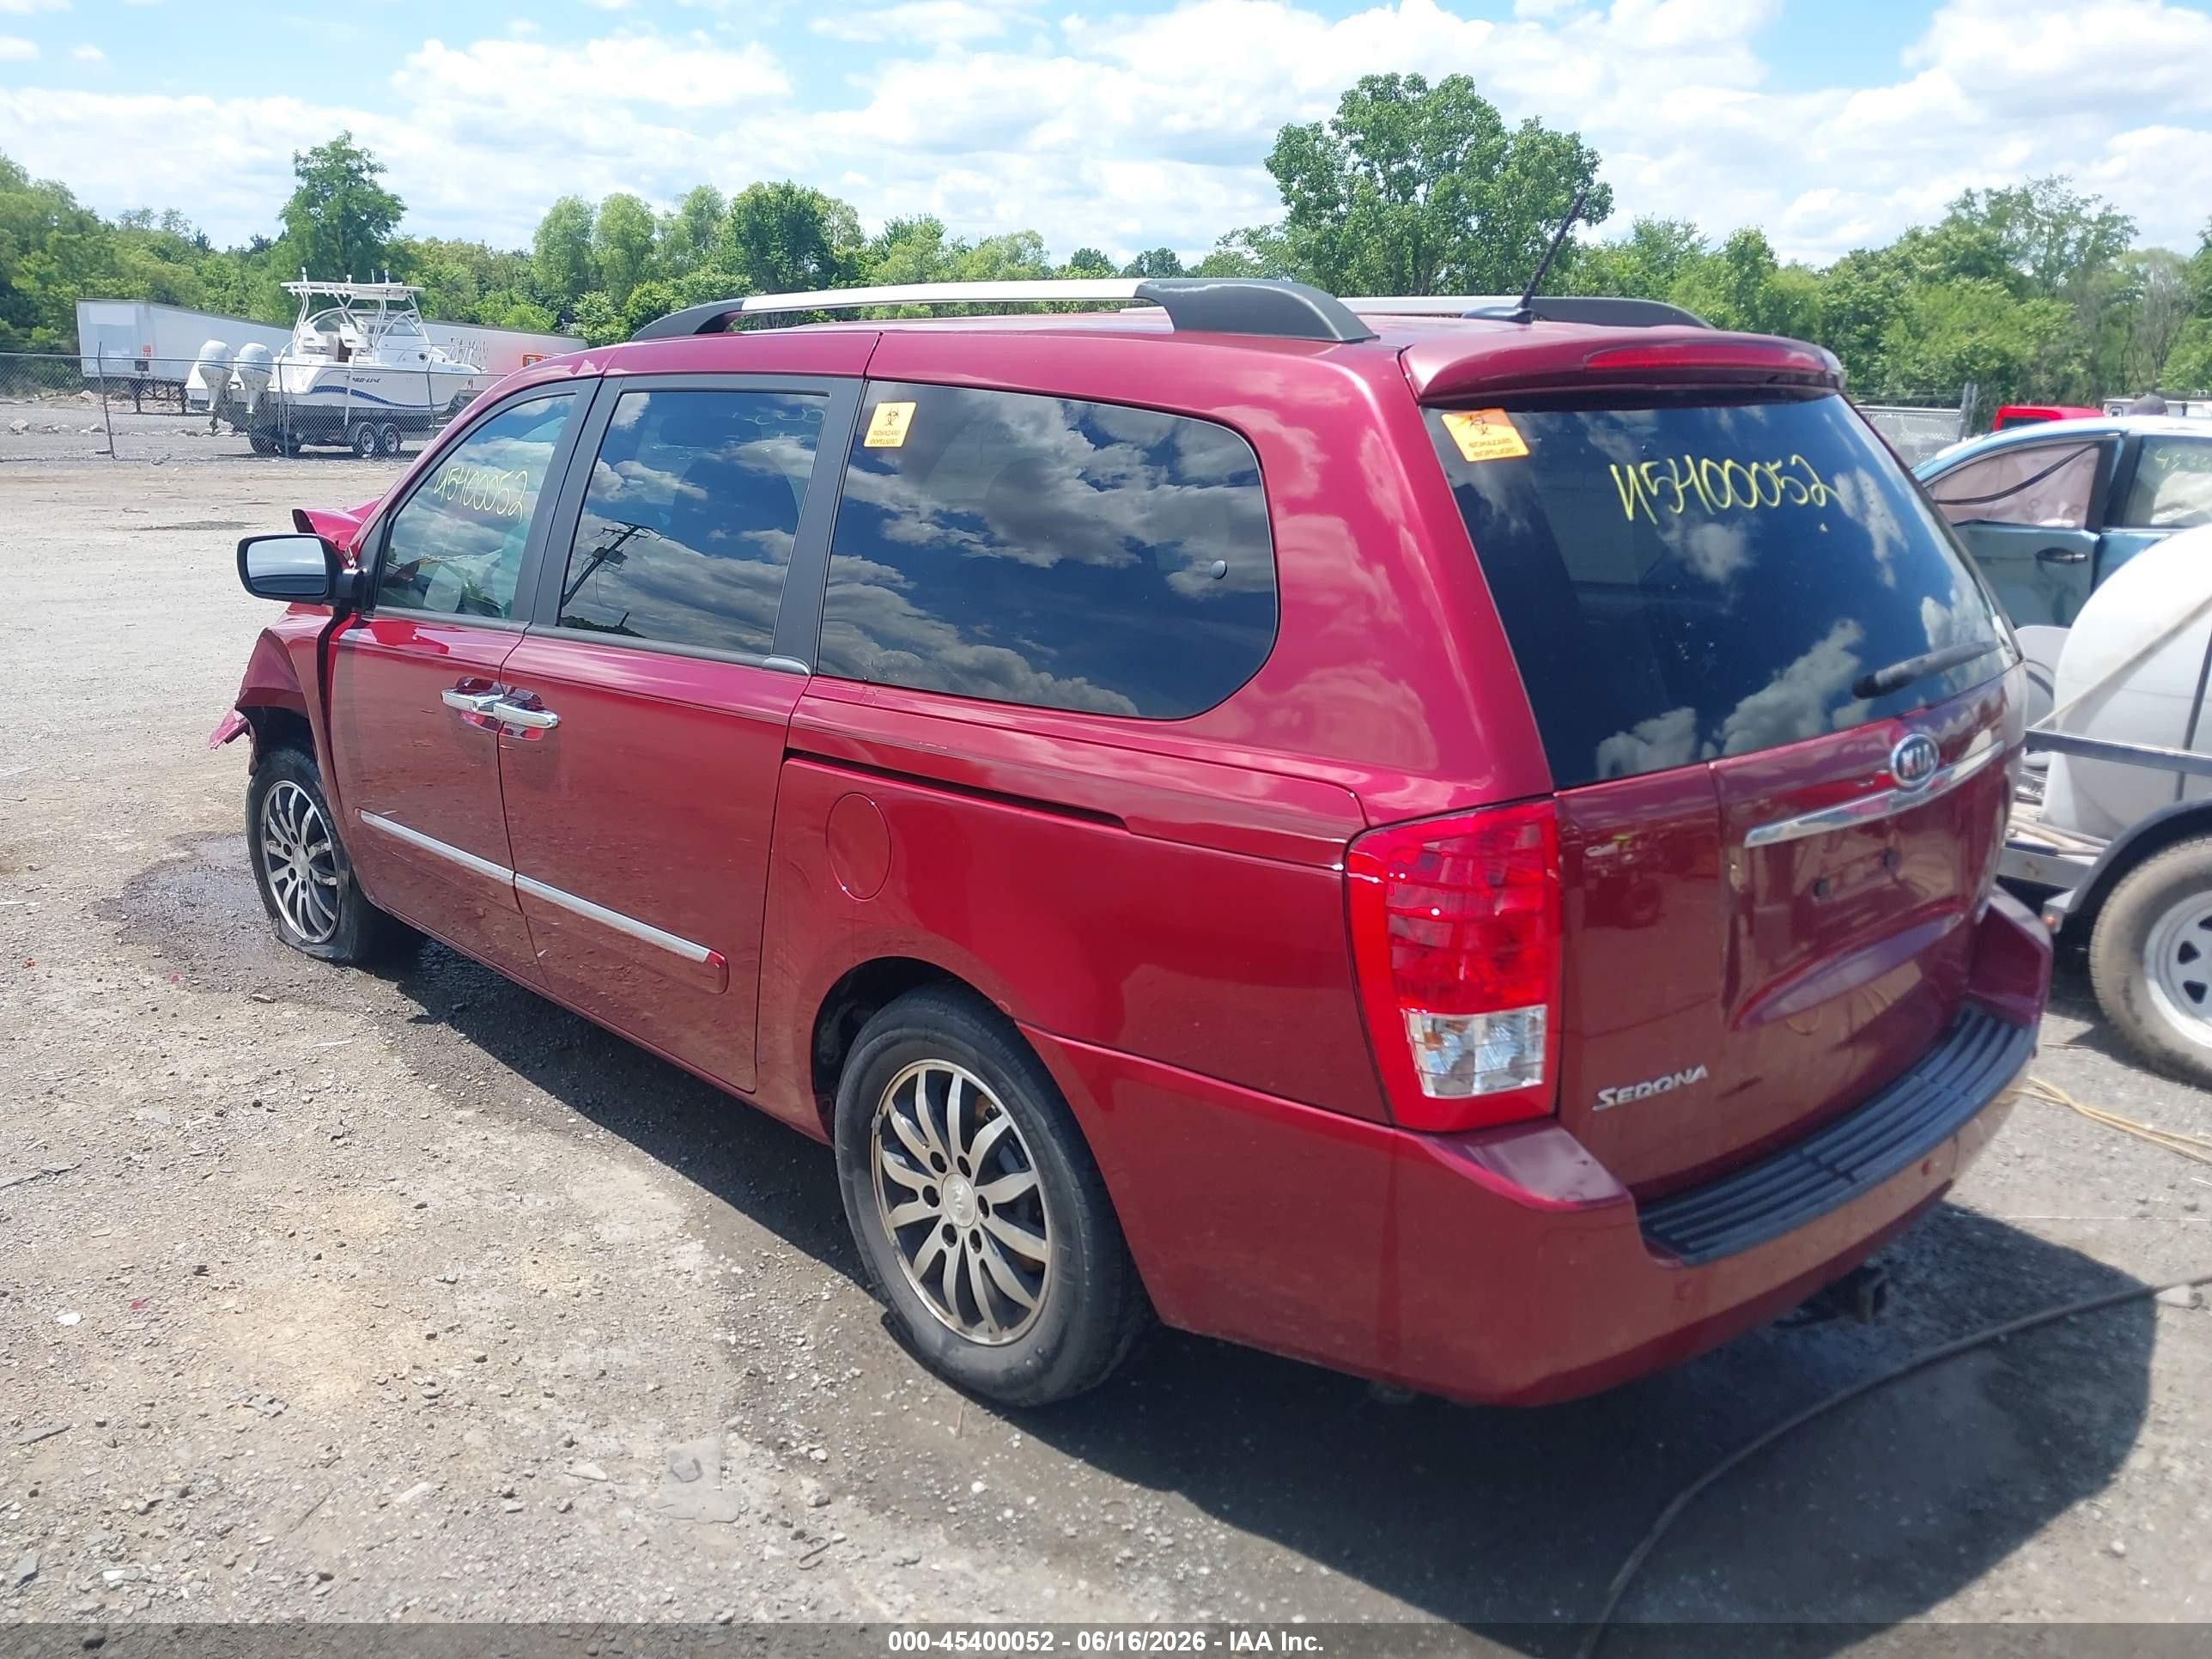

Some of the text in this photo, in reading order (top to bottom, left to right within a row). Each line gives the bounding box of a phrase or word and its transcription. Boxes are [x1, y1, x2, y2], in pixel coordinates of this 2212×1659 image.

[433, 466, 528, 524] 45400052
[1608, 453, 1845, 526] 45400052
[1901, 744, 1935, 777] KIA
[1591, 1064, 1708, 1111] SEDONA
